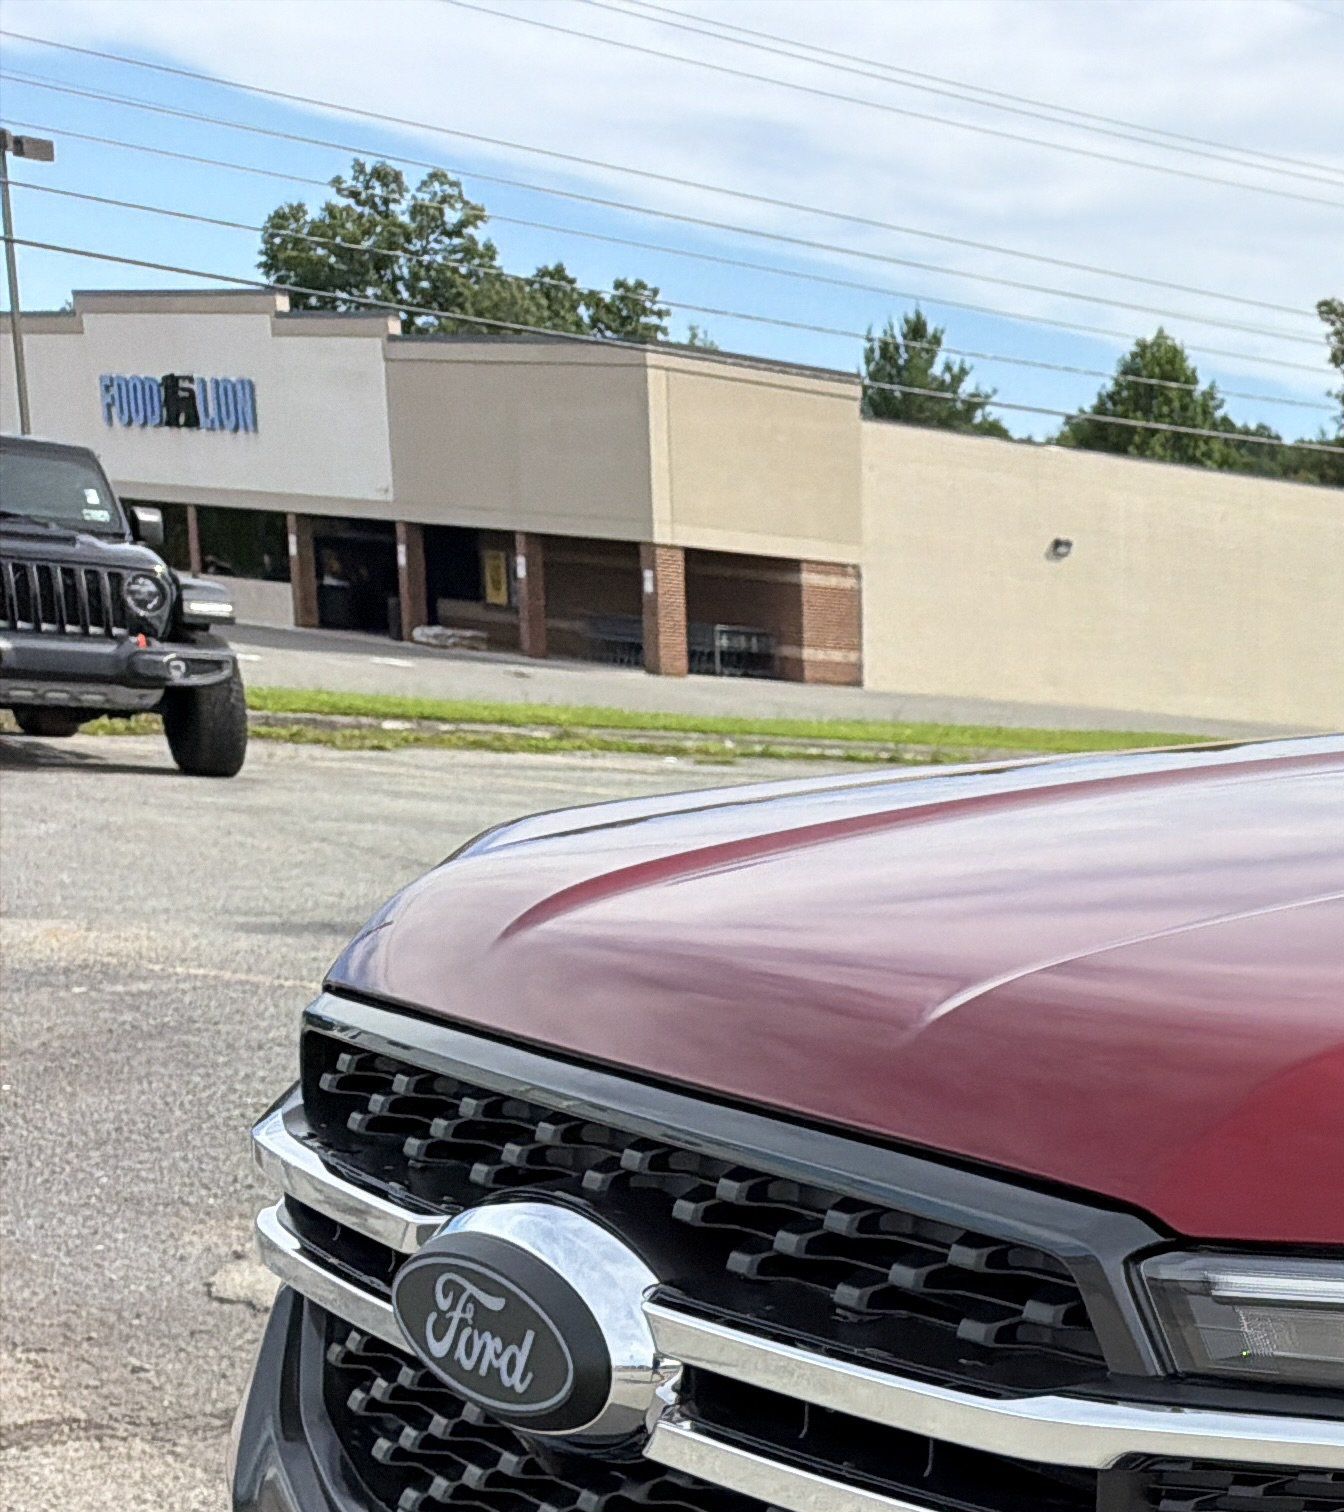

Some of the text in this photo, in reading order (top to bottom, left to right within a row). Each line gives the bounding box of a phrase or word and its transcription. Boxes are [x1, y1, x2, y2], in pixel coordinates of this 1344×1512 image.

[99, 374, 259, 433] FOOD LION
[425, 1272, 536, 1394] Ford
